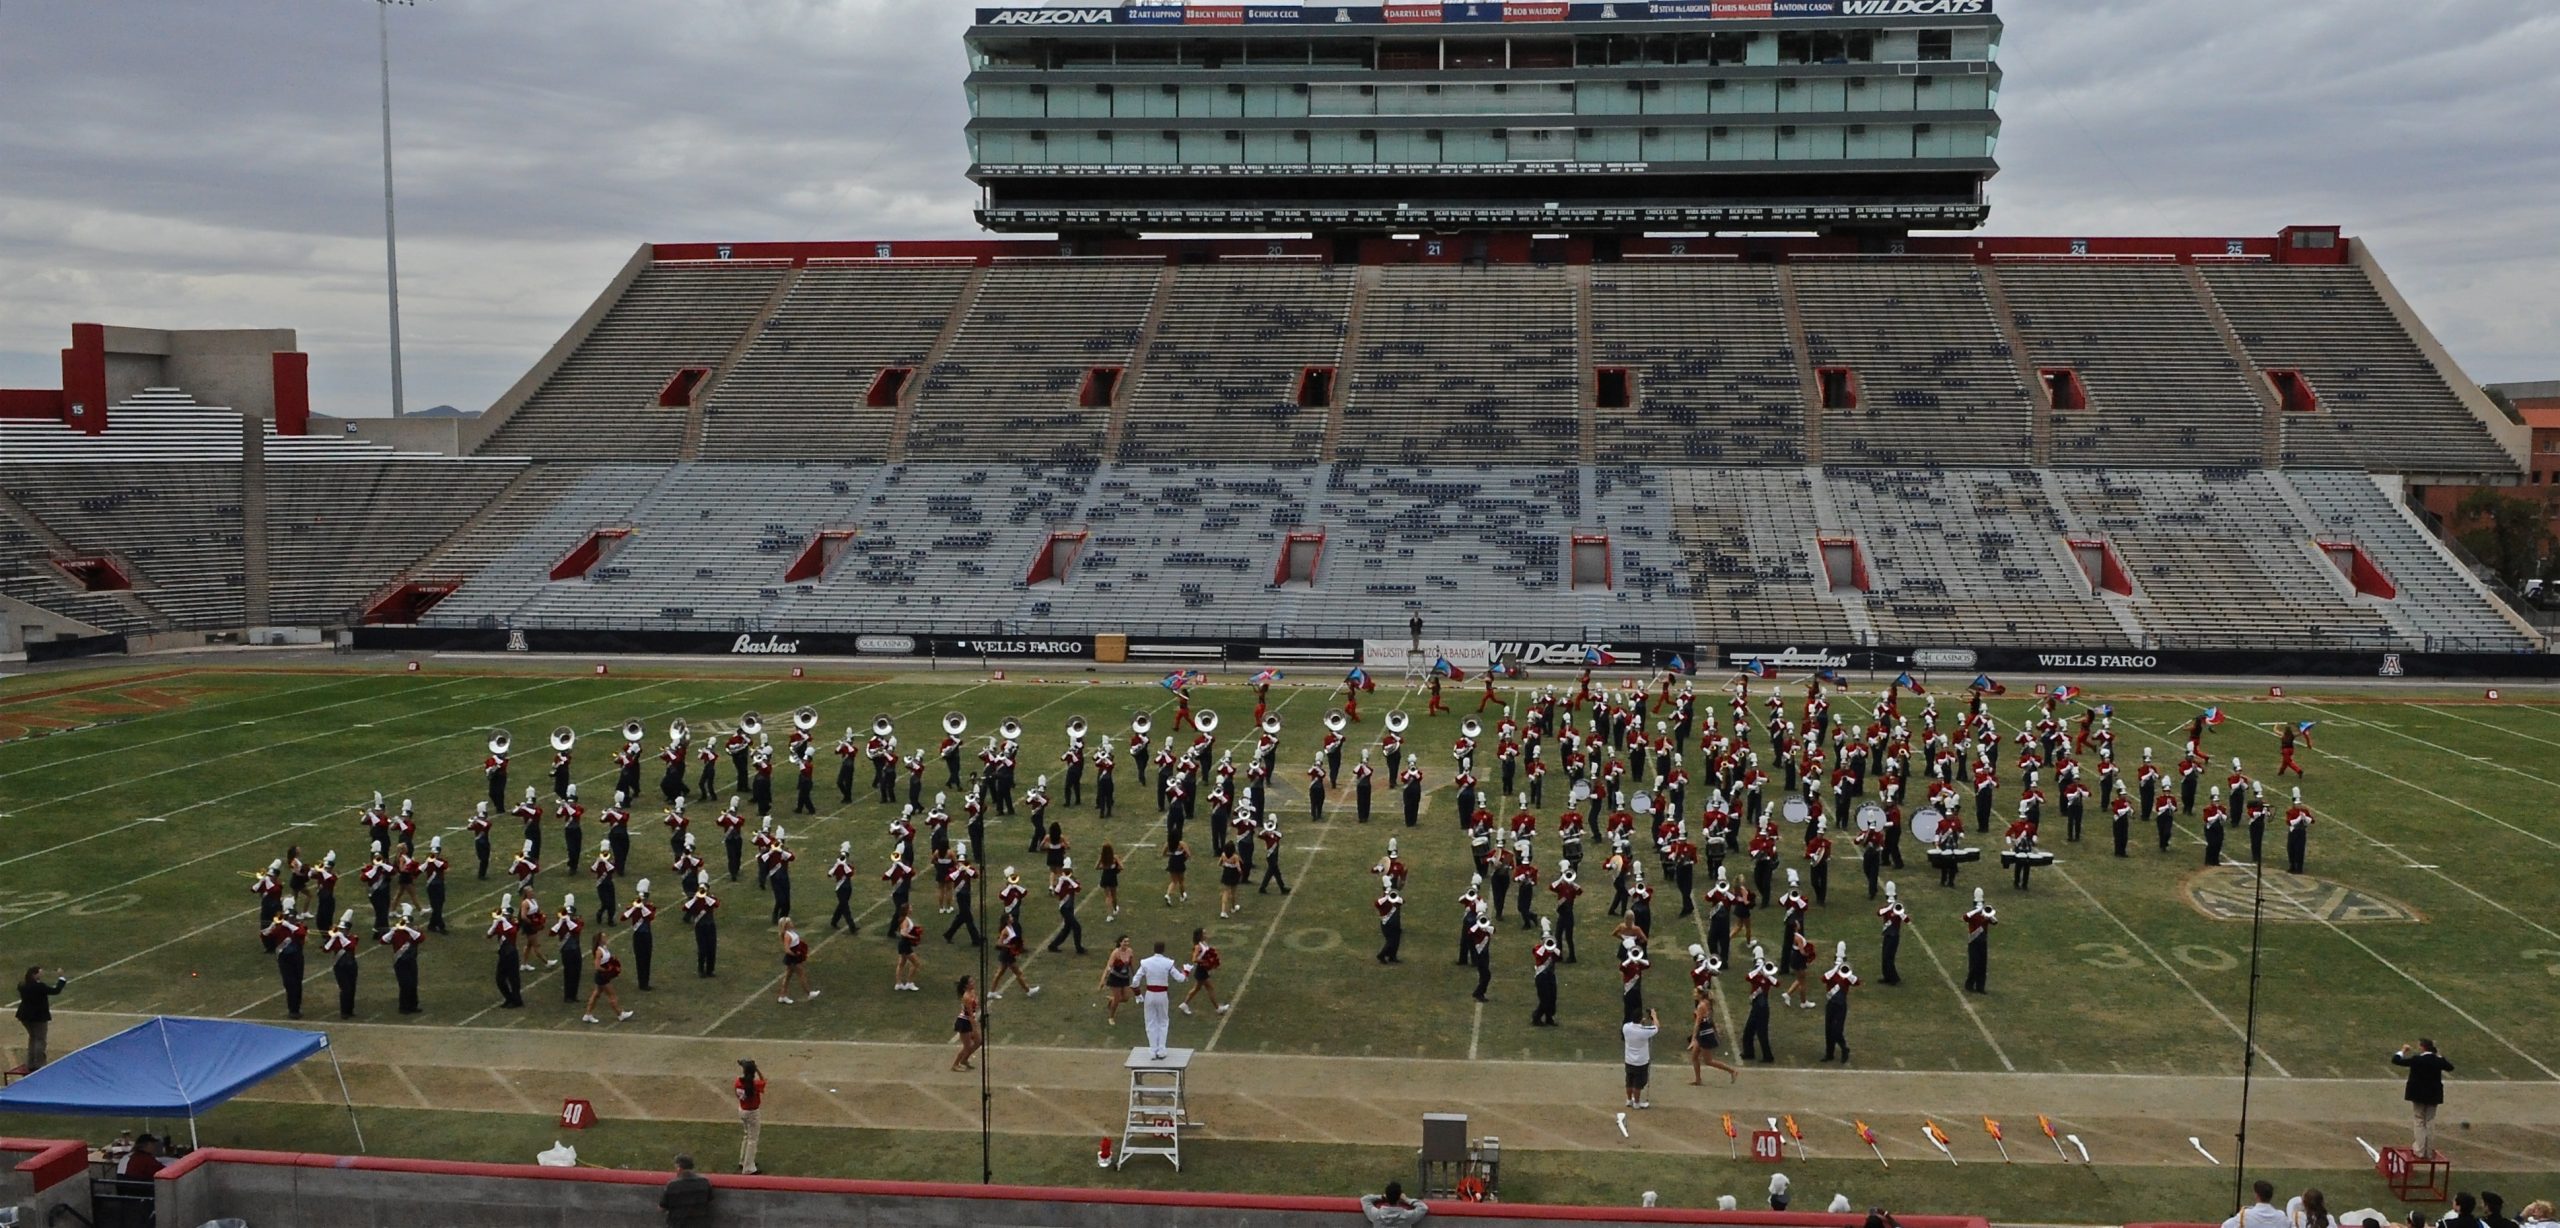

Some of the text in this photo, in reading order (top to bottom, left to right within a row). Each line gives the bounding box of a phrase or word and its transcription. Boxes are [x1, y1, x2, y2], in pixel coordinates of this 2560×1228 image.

[1512, 7, 1527, 16] ROB
[1528, 6, 1562, 16] WALDROP
[1659, 5, 1674, 13] STEVE
[1718, 4, 1738, 12] CHRIS
[1779, 3, 1808, 11] ANTOINE
[1808, 2, 1833, 11] CASON
[1842, 0, 1985, 14] WILDCATS
[990, 10, 1112, 24] ARIZONA
[1128, 10, 1182, 18] 22 ART LUPPINO
[1280, 10, 1298, 18] CECIL
[1390, 10, 1419, 18] DARRYLL
[1420, 9, 1442, 18] LEWIS
[720, 250, 730, 260] 17
[878, 249, 890, 258] 18
[1268, 246, 1282, 256] 20
[1428, 245, 1440, 255] 21
[1672, 245, 1685, 255] 22
[2072, 245, 2086, 255] 24
[2228, 246, 2242, 255] 25
[72, 405, 83, 414] 15
[731, 634, 800, 653] Bashas'
[972, 641, 1082, 653] WELLS FARGO
[1367, 648, 1404, 658] UNIVERSITY
[1449, 648, 1470, 658] BAND
[1472, 649, 1485, 658] DAY
[2038, 655, 2156, 668] WELLS FARGO
[2073, 942, 2239, 971] 30
[563, 1103, 583, 1124] 40
[1154, 1120, 1170, 1137] 50
[1756, 1136, 1777, 1157] 40
